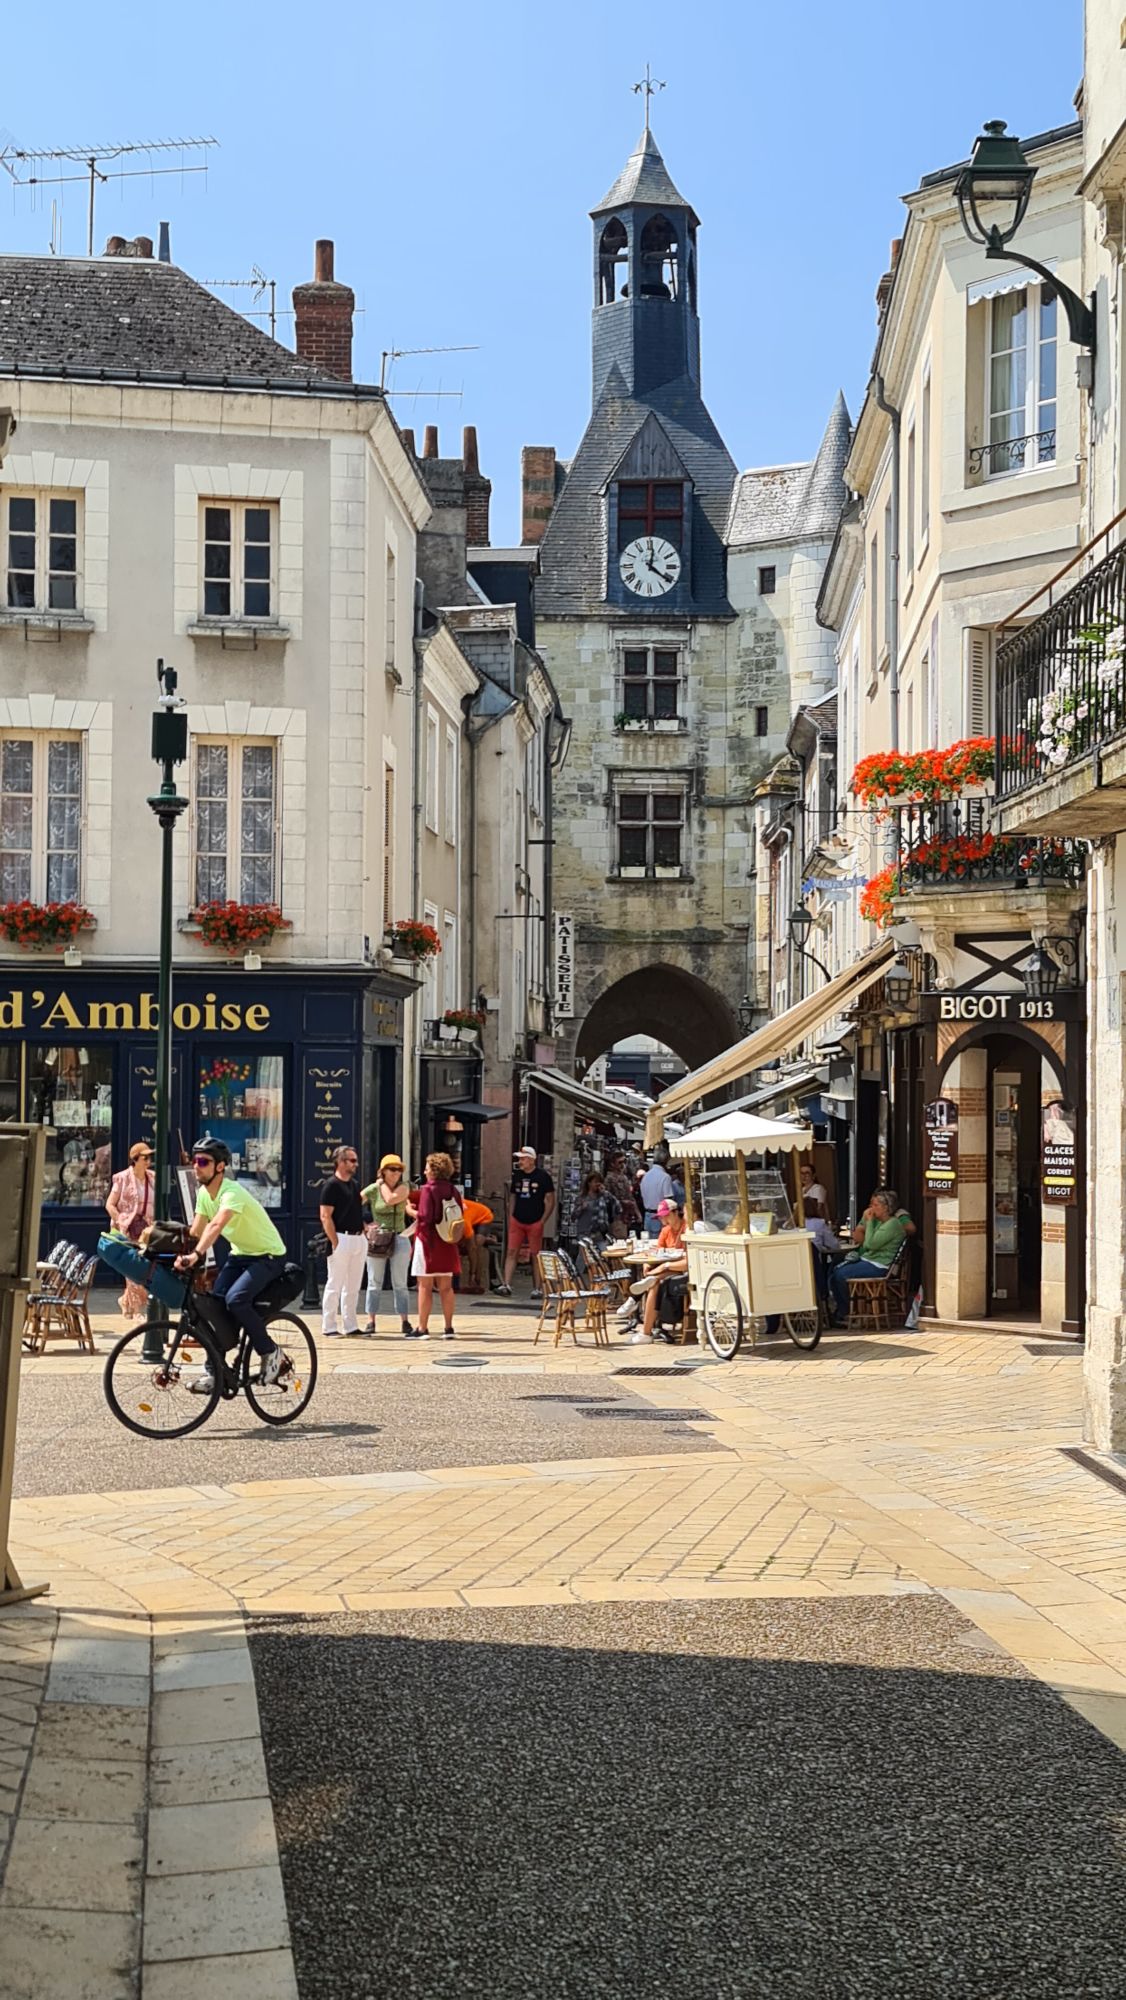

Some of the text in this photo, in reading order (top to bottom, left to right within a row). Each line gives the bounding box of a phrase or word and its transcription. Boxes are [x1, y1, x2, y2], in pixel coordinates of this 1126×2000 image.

[558, 916, 571, 1012] PATISSERIE
[940, 995, 1054, 1019] BIGOT 1913
[1044, 1146, 1074, 1155] GLACES
[1043, 1157, 1075, 1165] MAISON
[928, 1180, 953, 1189] BIGOT
[1047, 1187, 1071, 1195] BIGOT
[703, 1250, 729, 1266] BIGOT
